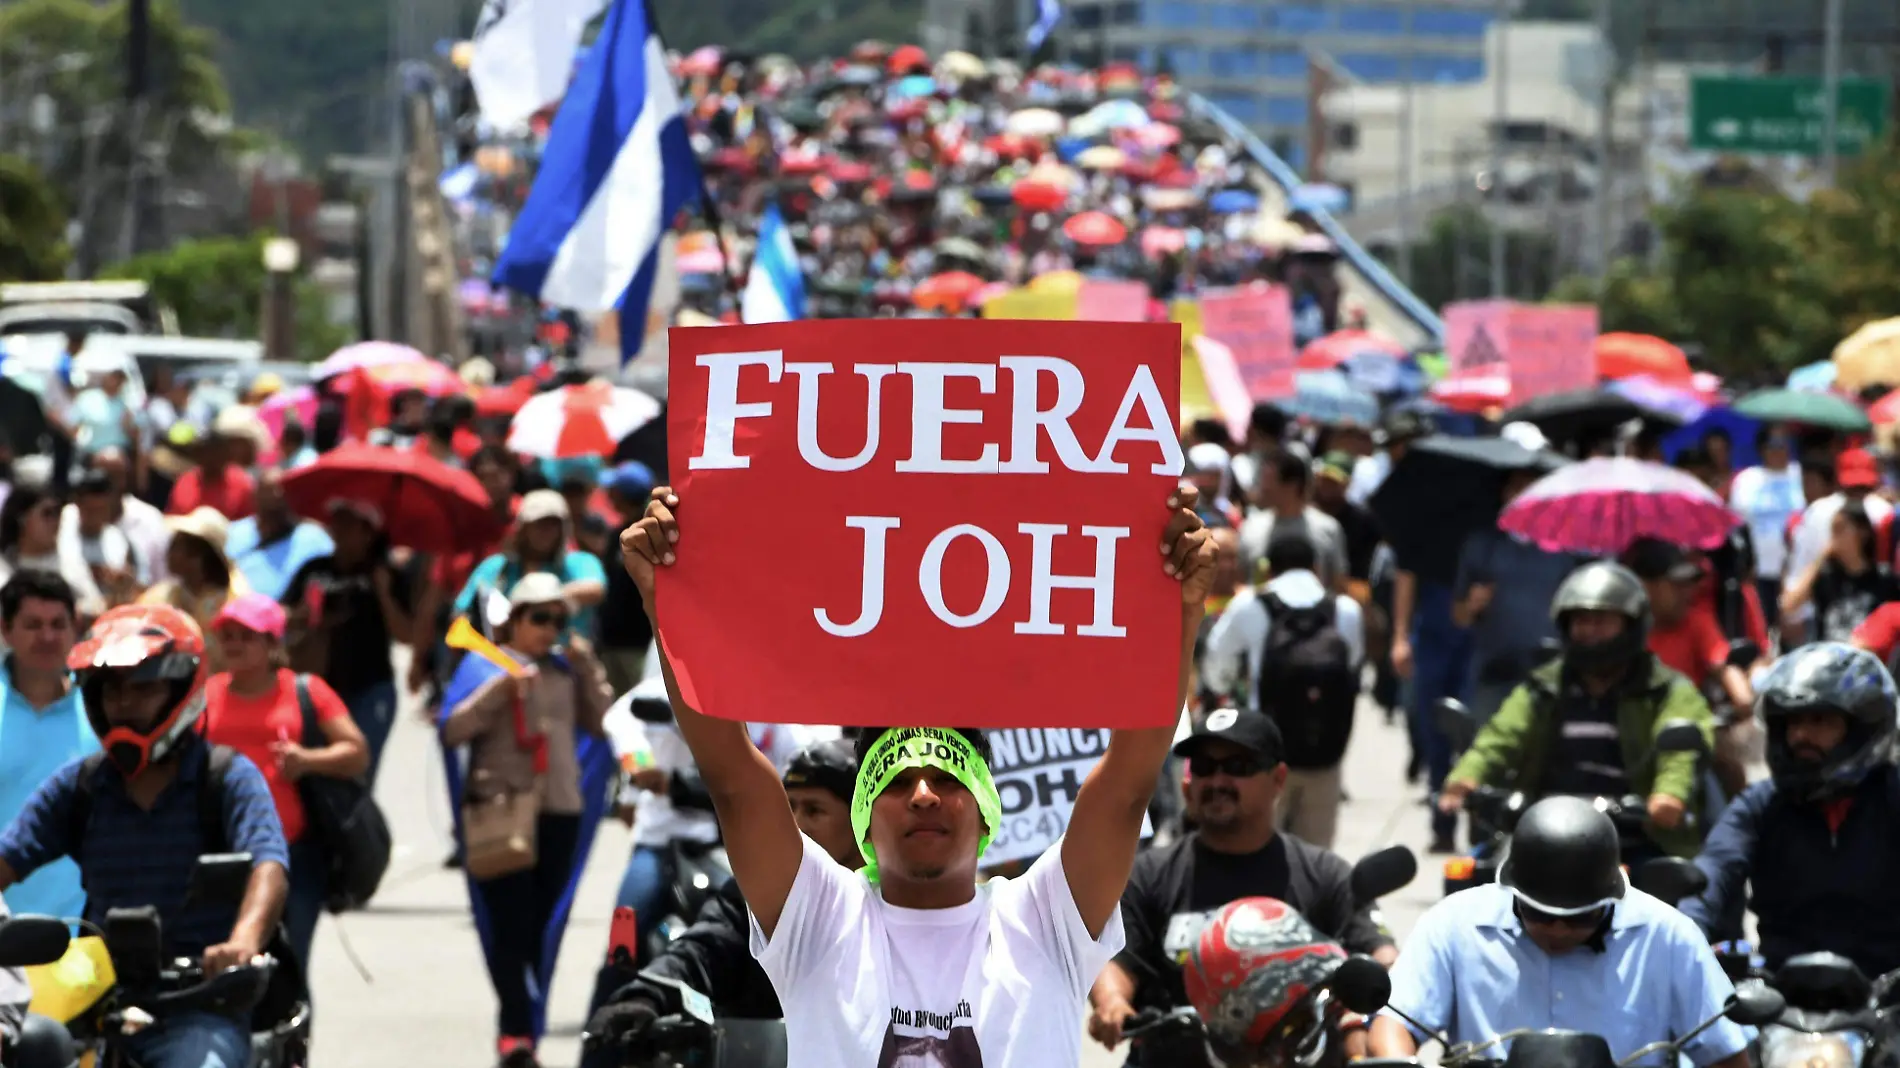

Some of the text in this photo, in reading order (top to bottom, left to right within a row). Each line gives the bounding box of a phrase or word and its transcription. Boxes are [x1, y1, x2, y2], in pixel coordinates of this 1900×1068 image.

[688, 349, 1186, 476] FUERA
[813, 516, 1130, 637] JOH
[896, 728, 922, 744] JAMAS
[923, 727, 944, 741] SERA
[919, 742, 966, 771] JOH
[988, 728, 1111, 770] NUNCI
[996, 767, 1082, 815] OH
